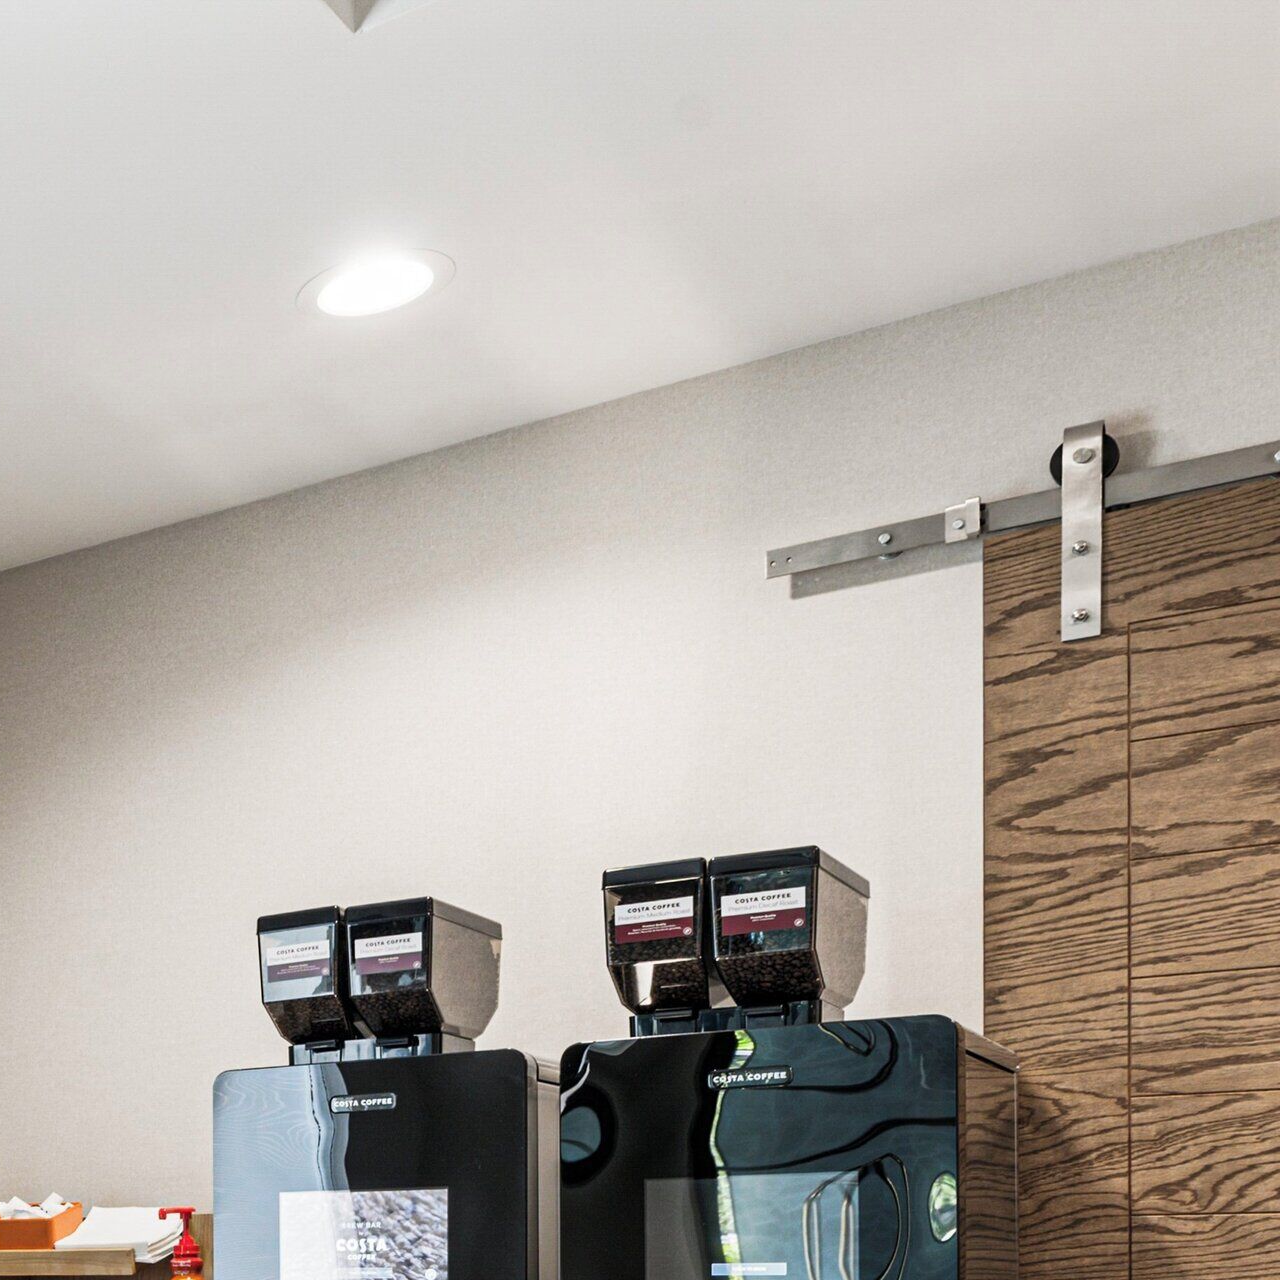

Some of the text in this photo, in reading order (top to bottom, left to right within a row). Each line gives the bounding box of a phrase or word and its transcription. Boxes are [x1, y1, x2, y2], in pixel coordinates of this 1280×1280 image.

[761, 893, 791, 901] COFFEE
[652, 902, 680, 910] COFFEE
[387, 937, 411, 945] COFFEE
[713, 1071, 787, 1083] COSTA COFFEE
[360, 1097, 392, 1106] COFFEE
[336, 1238, 389, 1253] COSTA
